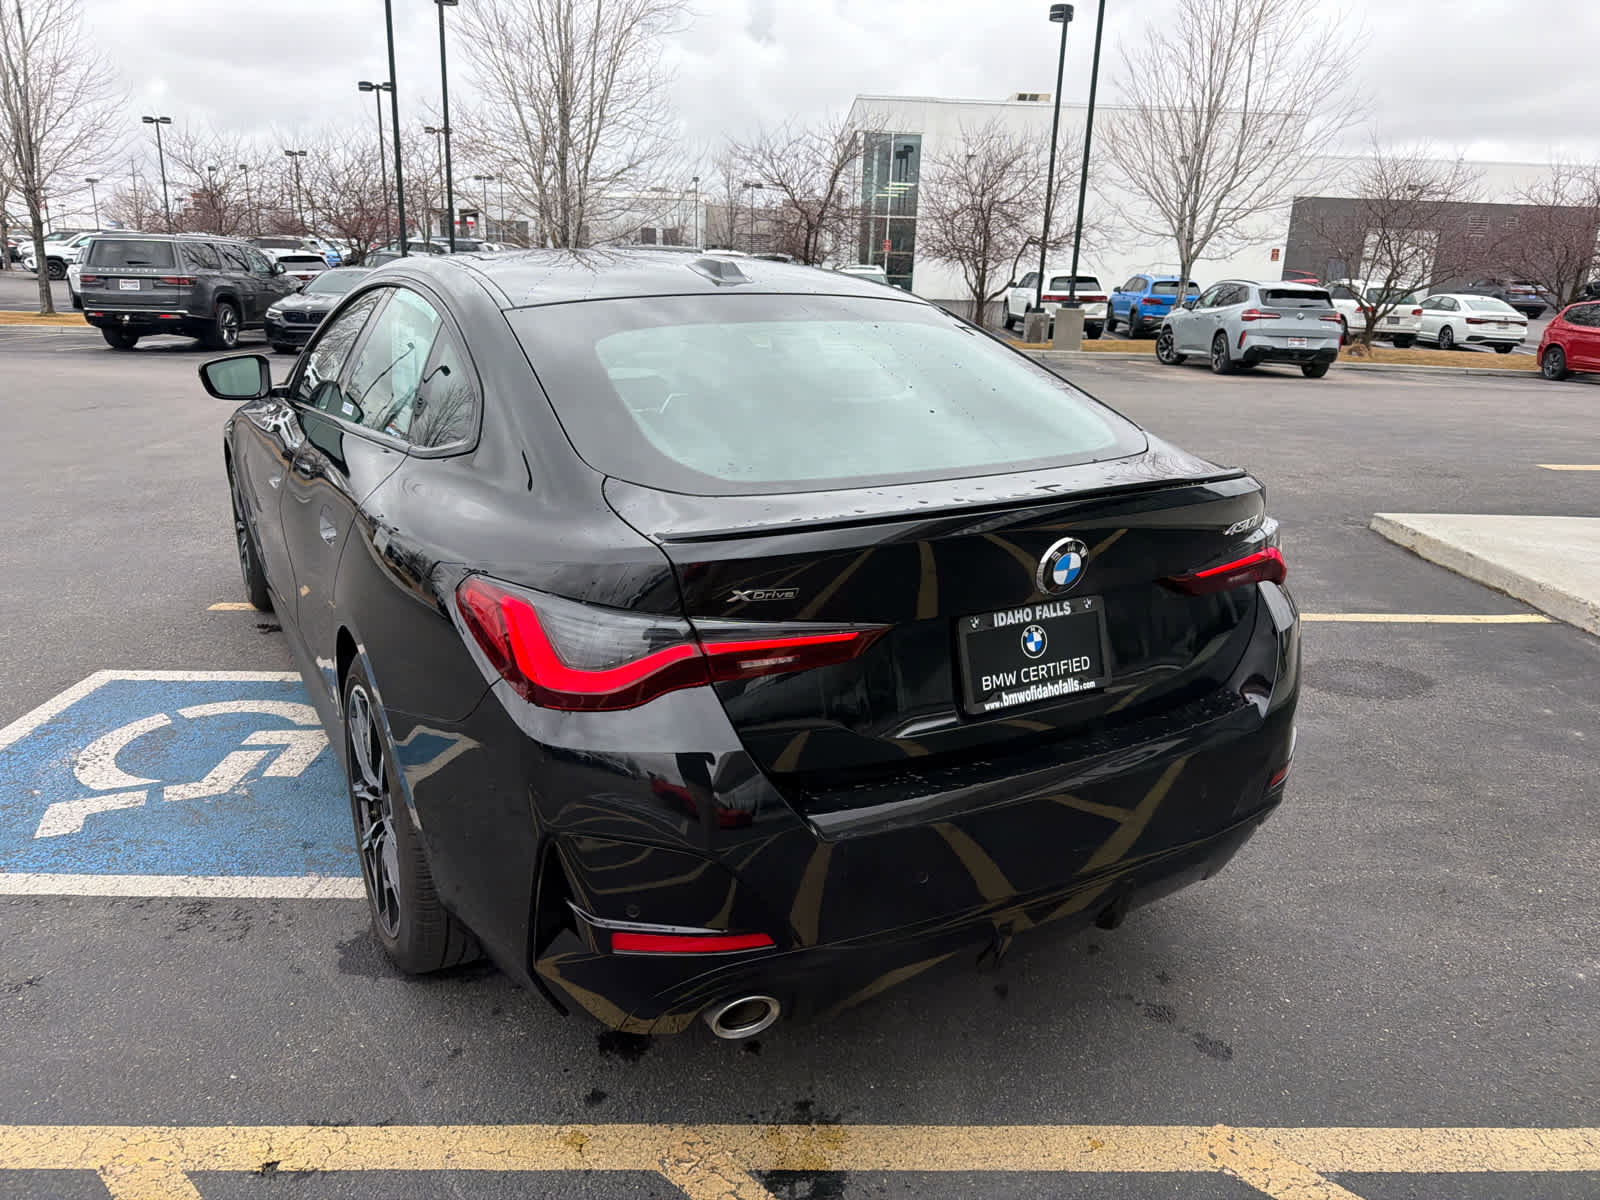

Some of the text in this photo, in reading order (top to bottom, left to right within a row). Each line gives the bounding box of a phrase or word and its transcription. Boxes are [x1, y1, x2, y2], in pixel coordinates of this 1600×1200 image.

[993, 601, 1072, 628] IDAHO FALLS
[982, 656, 1091, 691] BMW CERTIFIED
[984, 677, 1096, 711] www.bmwofidahofalls.com
